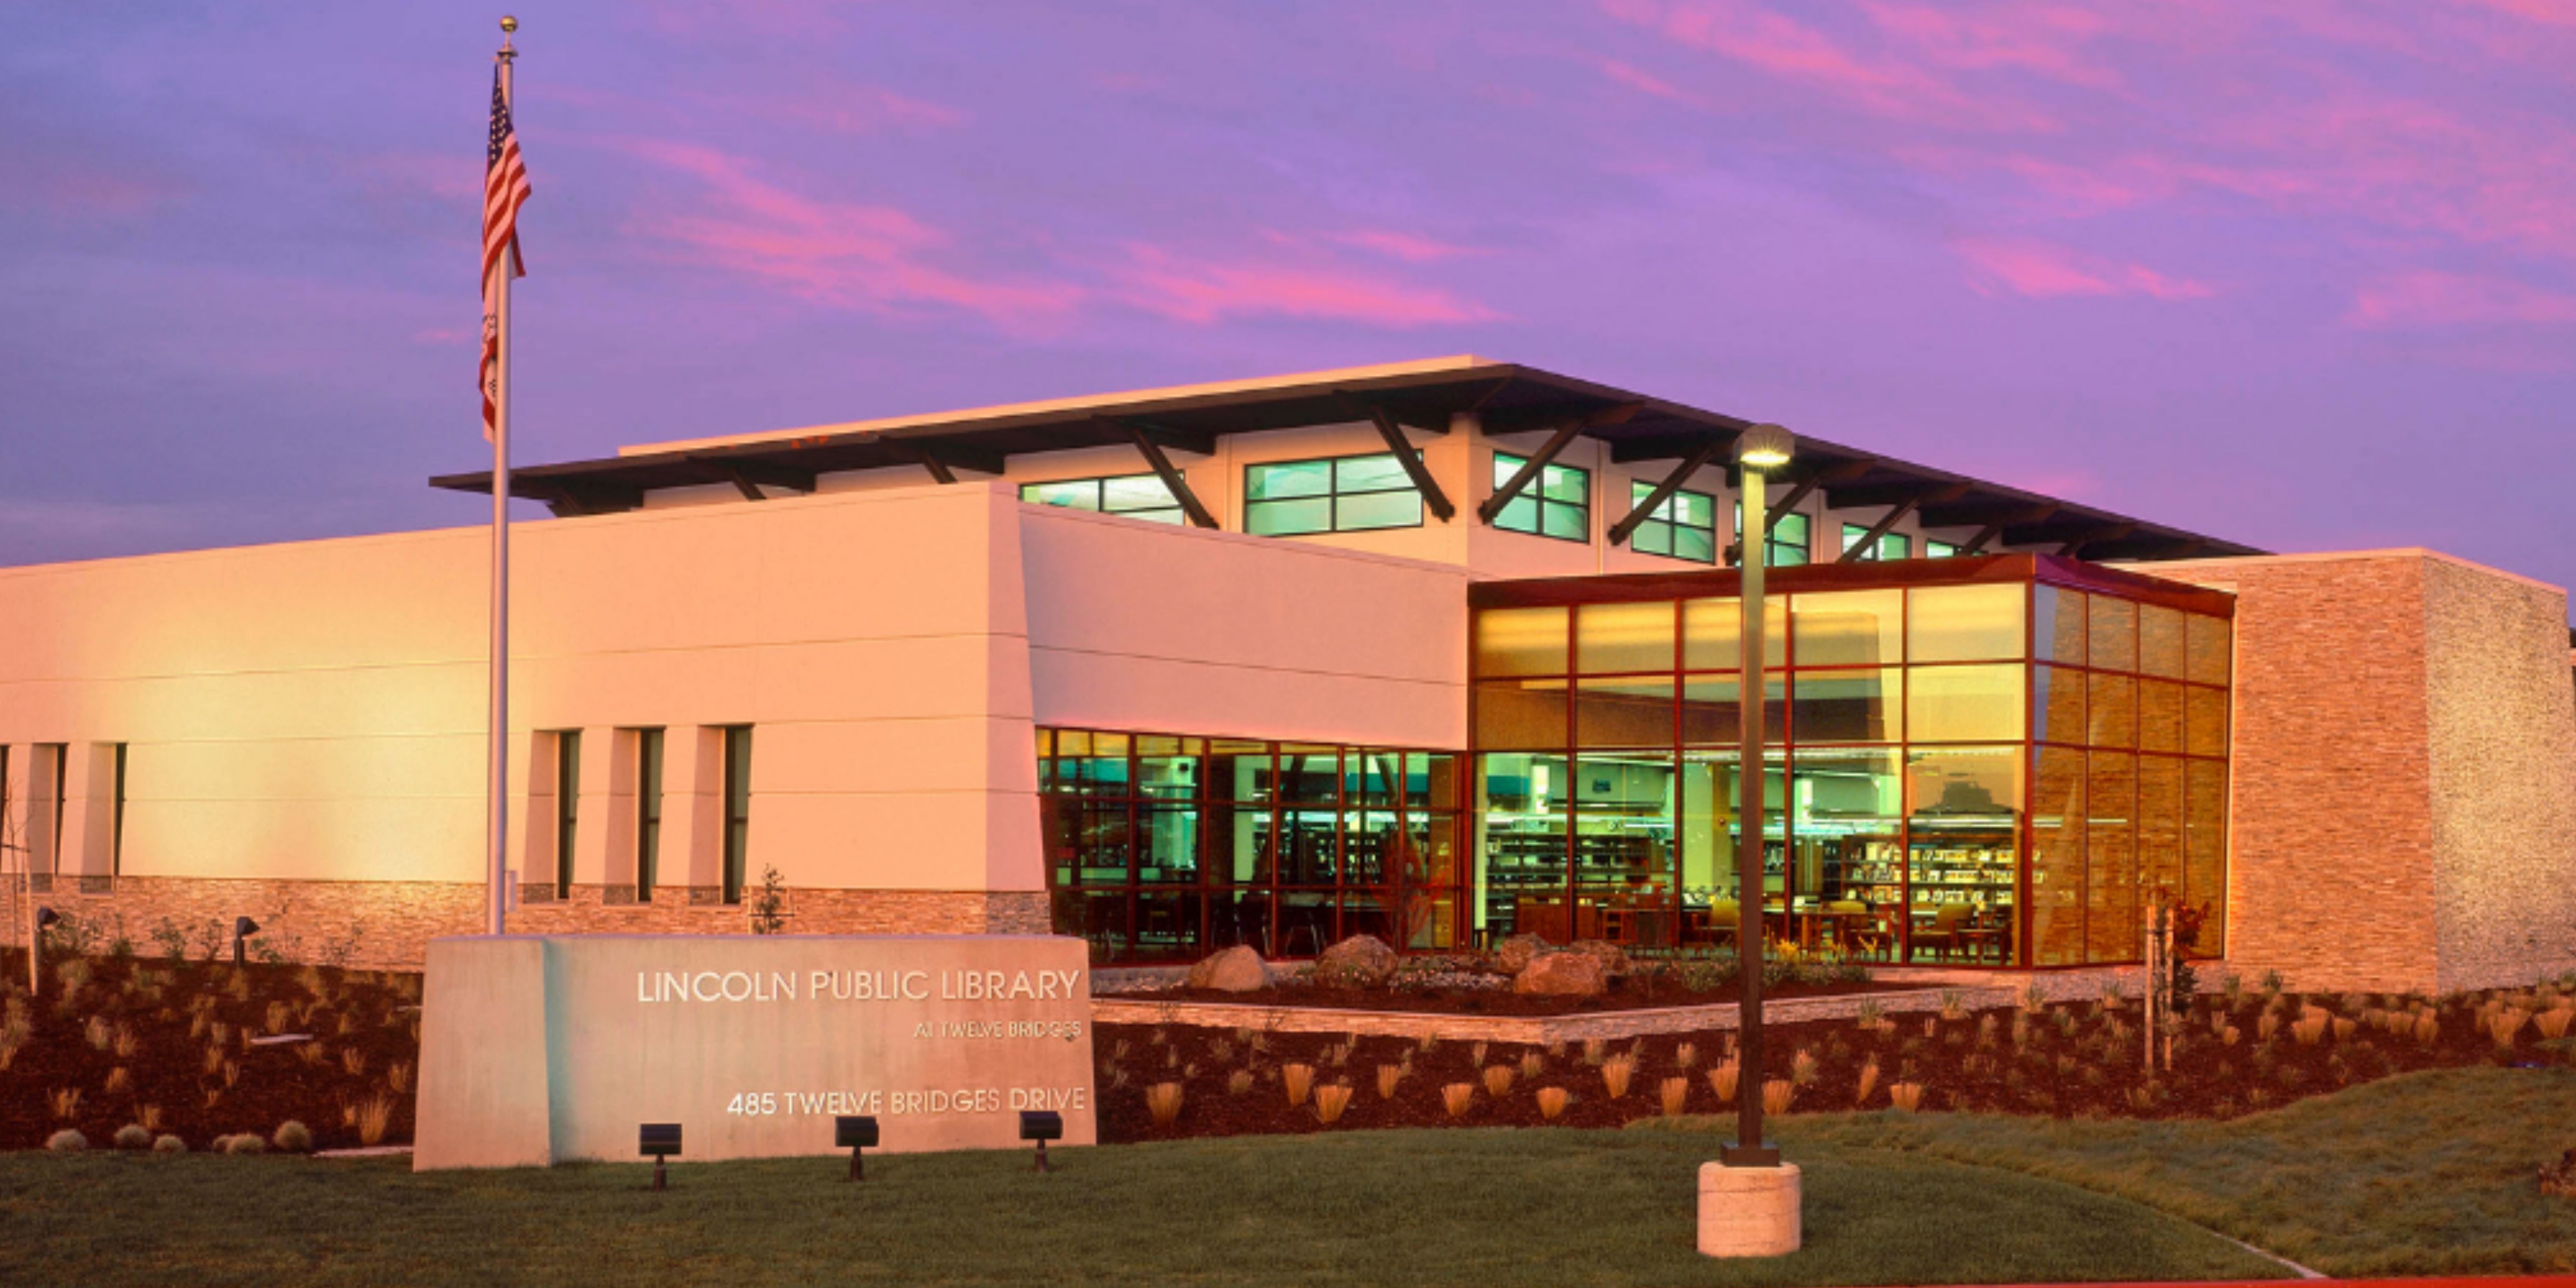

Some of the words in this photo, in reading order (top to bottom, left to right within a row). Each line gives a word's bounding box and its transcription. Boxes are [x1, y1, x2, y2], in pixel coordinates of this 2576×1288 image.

[638, 971, 796, 1002] LINCOLN
[811, 970, 930, 1000] PUBLIC
[941, 969, 1080, 1000] LIBRARY
[913, 1021, 934, 1038] AT
[940, 1021, 1003, 1038] TWELVE
[1008, 1020, 1081, 1038] BRIDGES
[726, 1092, 777, 1116] 485
[784, 1090, 883, 1115] TWELVE
[891, 1089, 1000, 1114] BRIDGES
[1009, 1087, 1085, 1110] DRIVE
